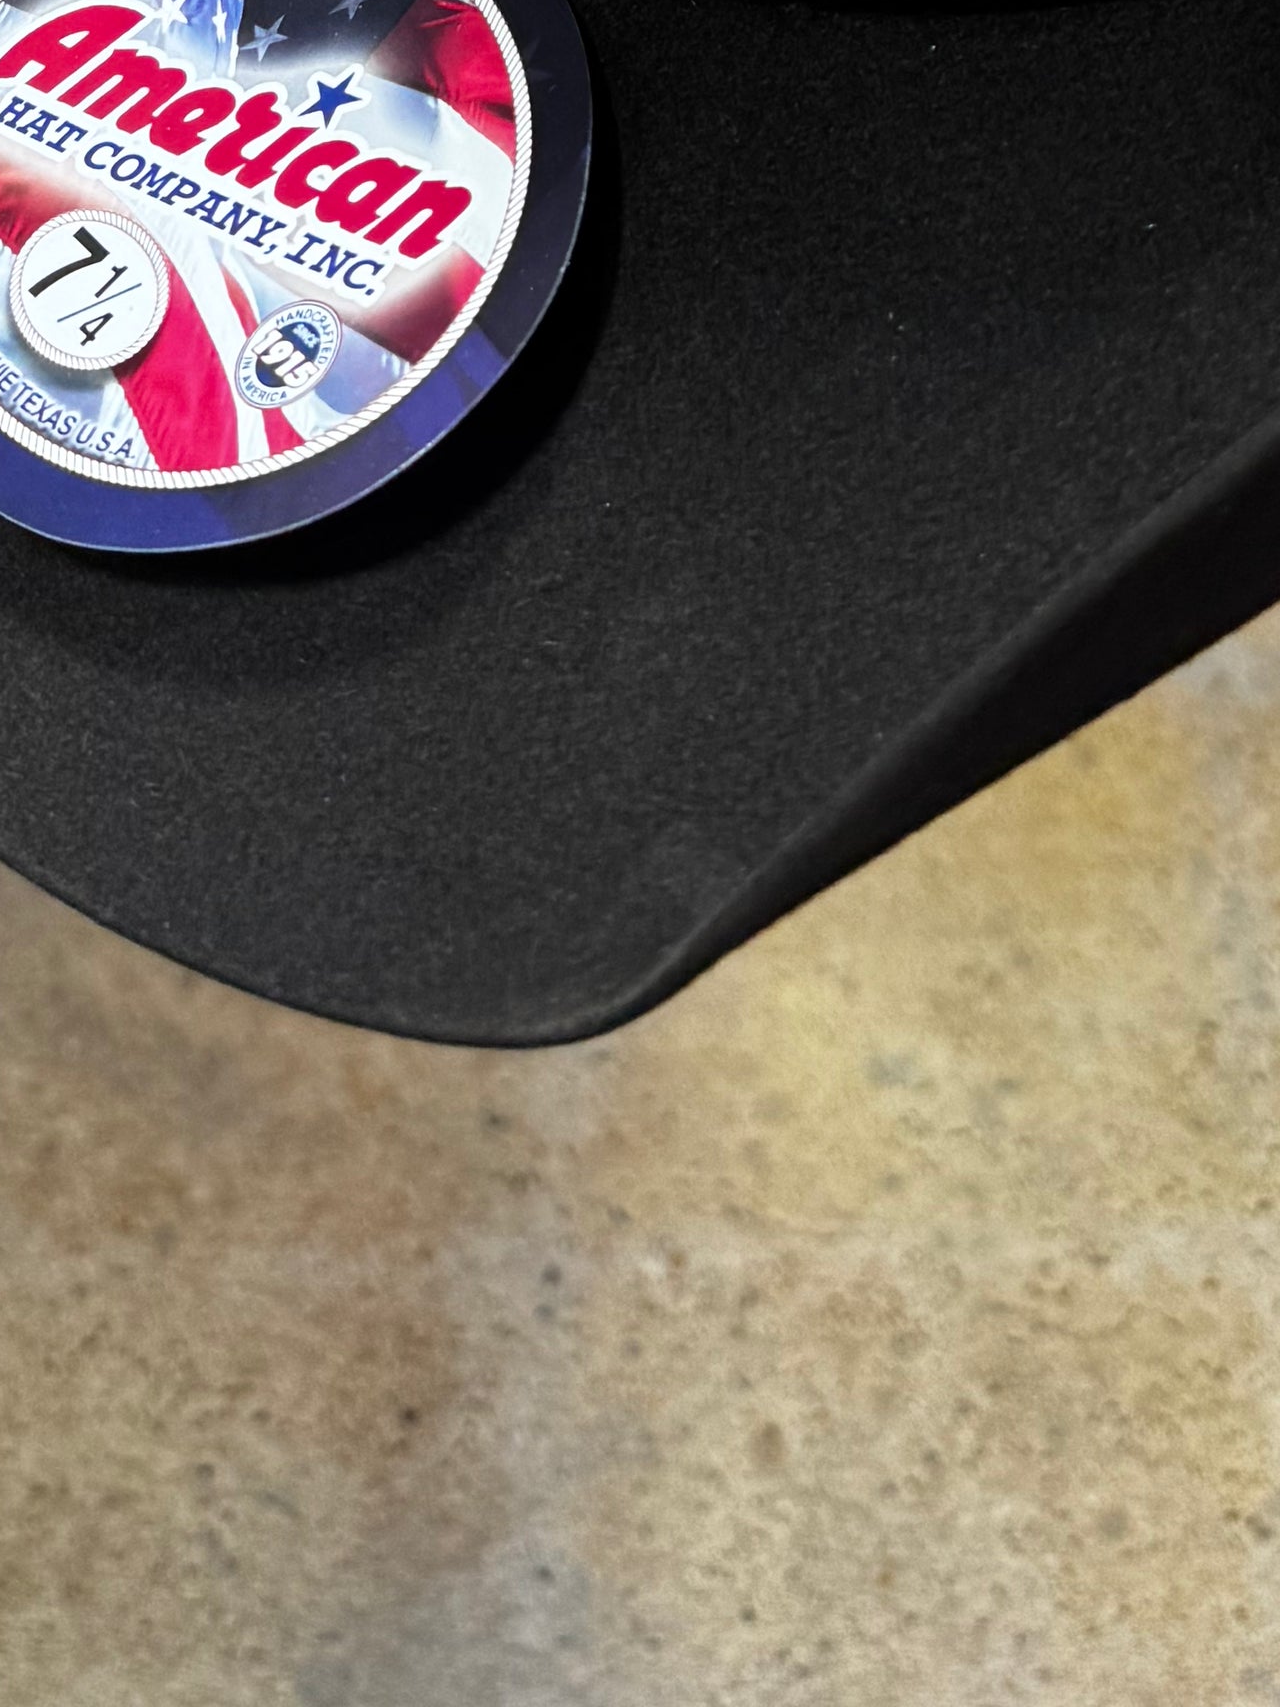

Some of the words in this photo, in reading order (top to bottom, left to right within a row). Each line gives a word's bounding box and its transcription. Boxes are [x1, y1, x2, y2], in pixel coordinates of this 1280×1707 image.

[83, 140, 287, 255] COMPANY,
[283, 232, 386, 297] INC.
[28, 226, 110, 298] 7
[241, 356, 254, 370] IN
[251, 327, 320, 389] 1915
[275, 308, 335, 365] HANDCRAFTED
[242, 374, 288, 403] AMERICA
[12, 381, 77, 436] TEXAS
[75, 422, 136, 460] U.S.A.
